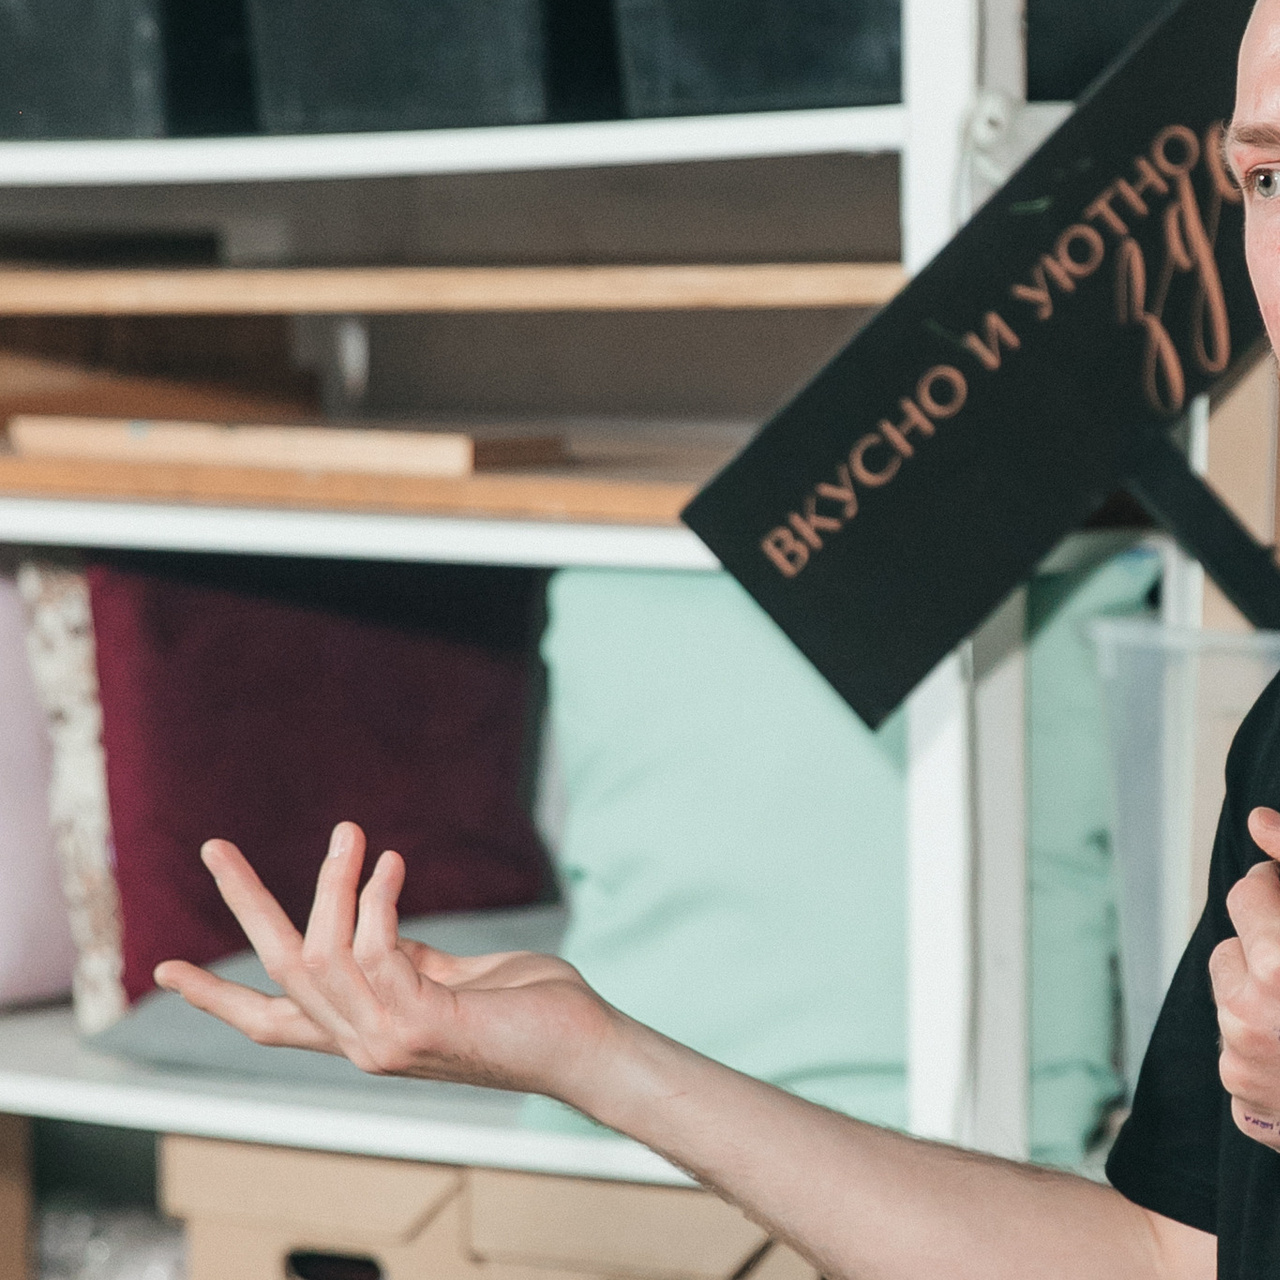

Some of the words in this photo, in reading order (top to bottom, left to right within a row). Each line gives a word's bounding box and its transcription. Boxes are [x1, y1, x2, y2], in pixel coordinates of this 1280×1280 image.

[759, 362, 970, 581] ВКУСНО
[962, 310, 1024, 374] И
[1010, 123, 1202, 323] УЮТНО
